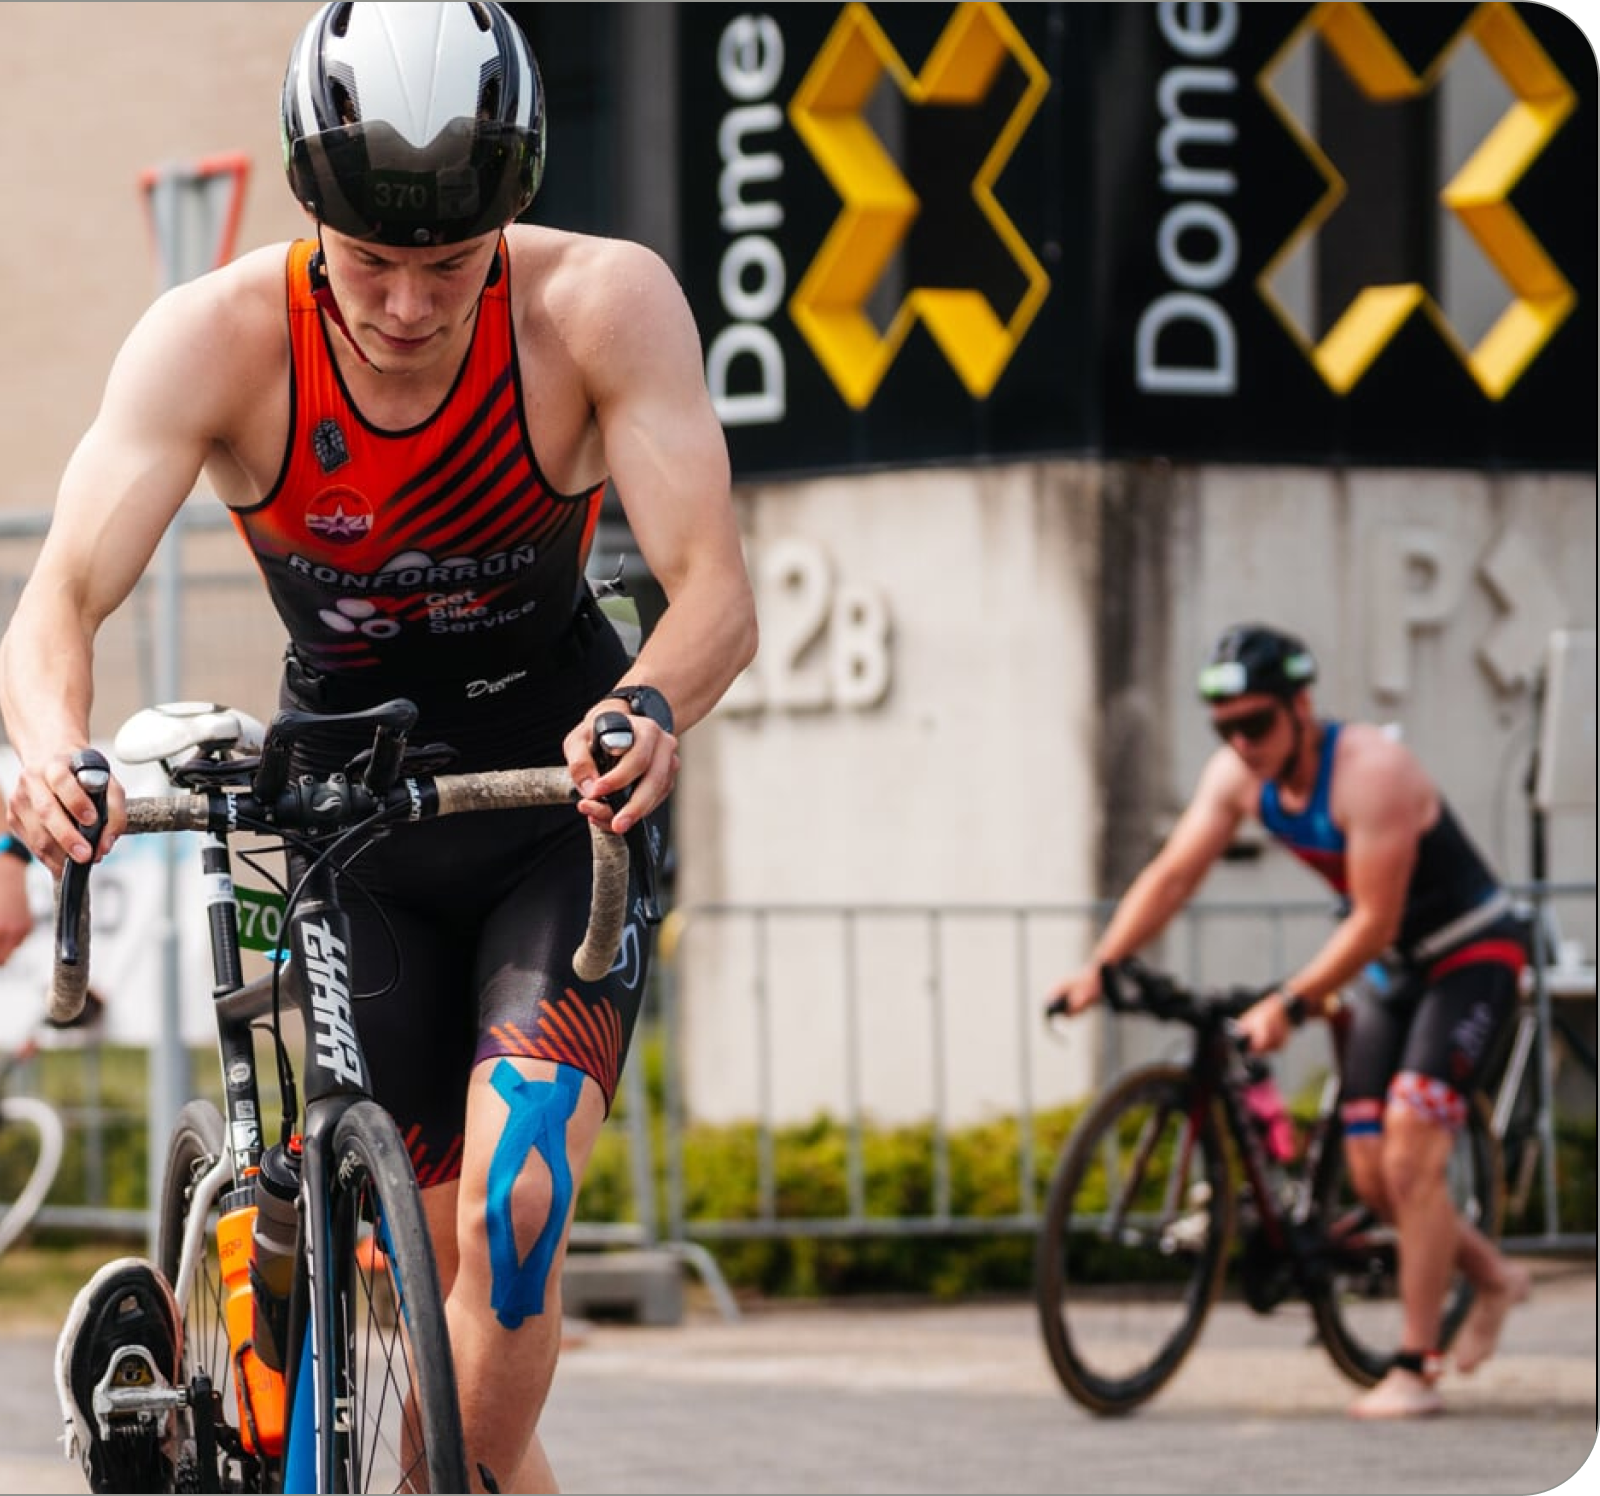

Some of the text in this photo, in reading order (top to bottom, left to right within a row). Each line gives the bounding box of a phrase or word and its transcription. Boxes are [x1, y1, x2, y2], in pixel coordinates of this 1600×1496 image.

[373, 182, 428, 209] 370
[1135, 1, 1239, 397] Dome
[707, 14, 785, 426] Dome
[287, 543, 537, 590] RONFORRUN
[424, 589, 479, 606] Get
[427, 604, 488, 623] Bike
[429, 600, 537, 635] Service
